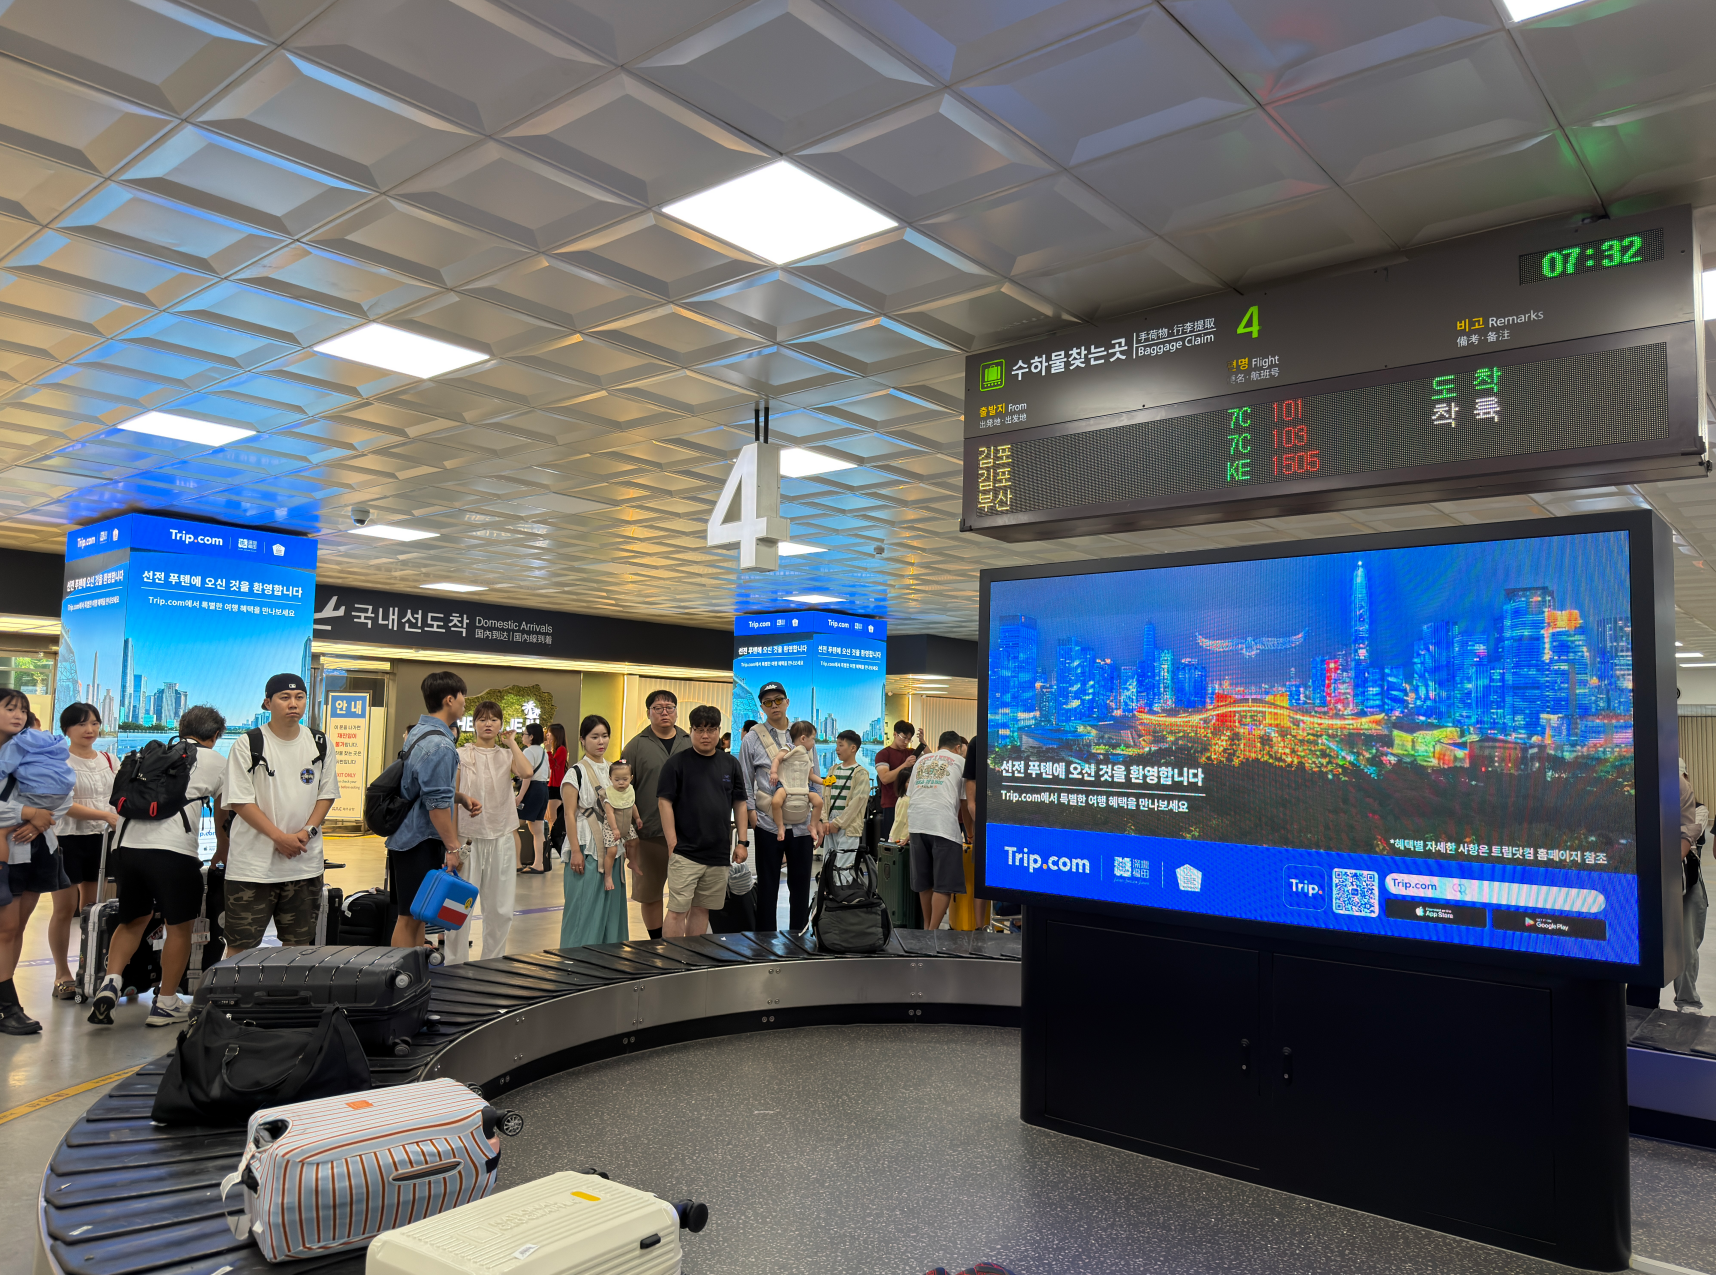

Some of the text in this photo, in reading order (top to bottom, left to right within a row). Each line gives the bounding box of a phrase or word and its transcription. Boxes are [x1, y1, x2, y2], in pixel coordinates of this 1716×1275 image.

[1541, 236, 1642, 277] 07:32
[1237, 305, 1262, 338] 4
[1457, 310, 1544, 332] 비고 Remarks
[1138, 333, 1214, 357] Baggage Claim
[1011, 338, 1128, 381] 수하물찾는곳
[1252, 355, 1280, 369] Flight
[979, 401, 1027, 418] 출발지 From
[979, 445, 1012, 468] 김포
[1227, 407, 1251, 429] 7C
[1273, 400, 1302, 422] 101
[979, 468, 1012, 490] 김포
[1227, 433, 1251, 455] 7C
[1273, 425, 1307, 448] 103
[978, 450, 1319, 512] 부산 KE 1505
[707, 442, 767, 570] 4
[77, 536, 96, 549] Trip.com
[170, 529, 223, 546] Trip.com
[142, 570, 165, 584] 선전
[205, 577, 226, 590] 오신
[229, 580, 250, 593] 것을
[253, 582, 303, 599] 환영합니다
[148, 596, 200, 609] Trip.com에서
[262, 607, 295, 617] 만나보세요
[351, 603, 470, 637] 국내선도착
[475, 616, 553, 634] Domestic Arrivals
[748, 620, 771, 629] Trip.com
[828, 619, 850, 629] Trip.com
[1000, 760, 1025, 777] 선전
[1069, 763, 1096, 780] 오신
[1099, 764, 1127, 783] 것을
[1129, 765, 1204, 787] 환영합니다
[1000, 790, 1189, 813] Trip.com에서 특별한 여행 혜택을 만나보세요
[1004, 846, 1090, 874] Trip.com
[1425, 840, 1456, 854] 자세한
[1458, 843, 1489, 857] 사항은
[1491, 845, 1534, 860] 트립닷컴
[1537, 848, 1581, 863] 홈페이지
[1583, 851, 1608, 864] 참조
[1289, 878, 1323, 897] Trip.
[1391, 878, 1437, 891] Trip.com
[1536, 922, 1569, 931] Google Play
